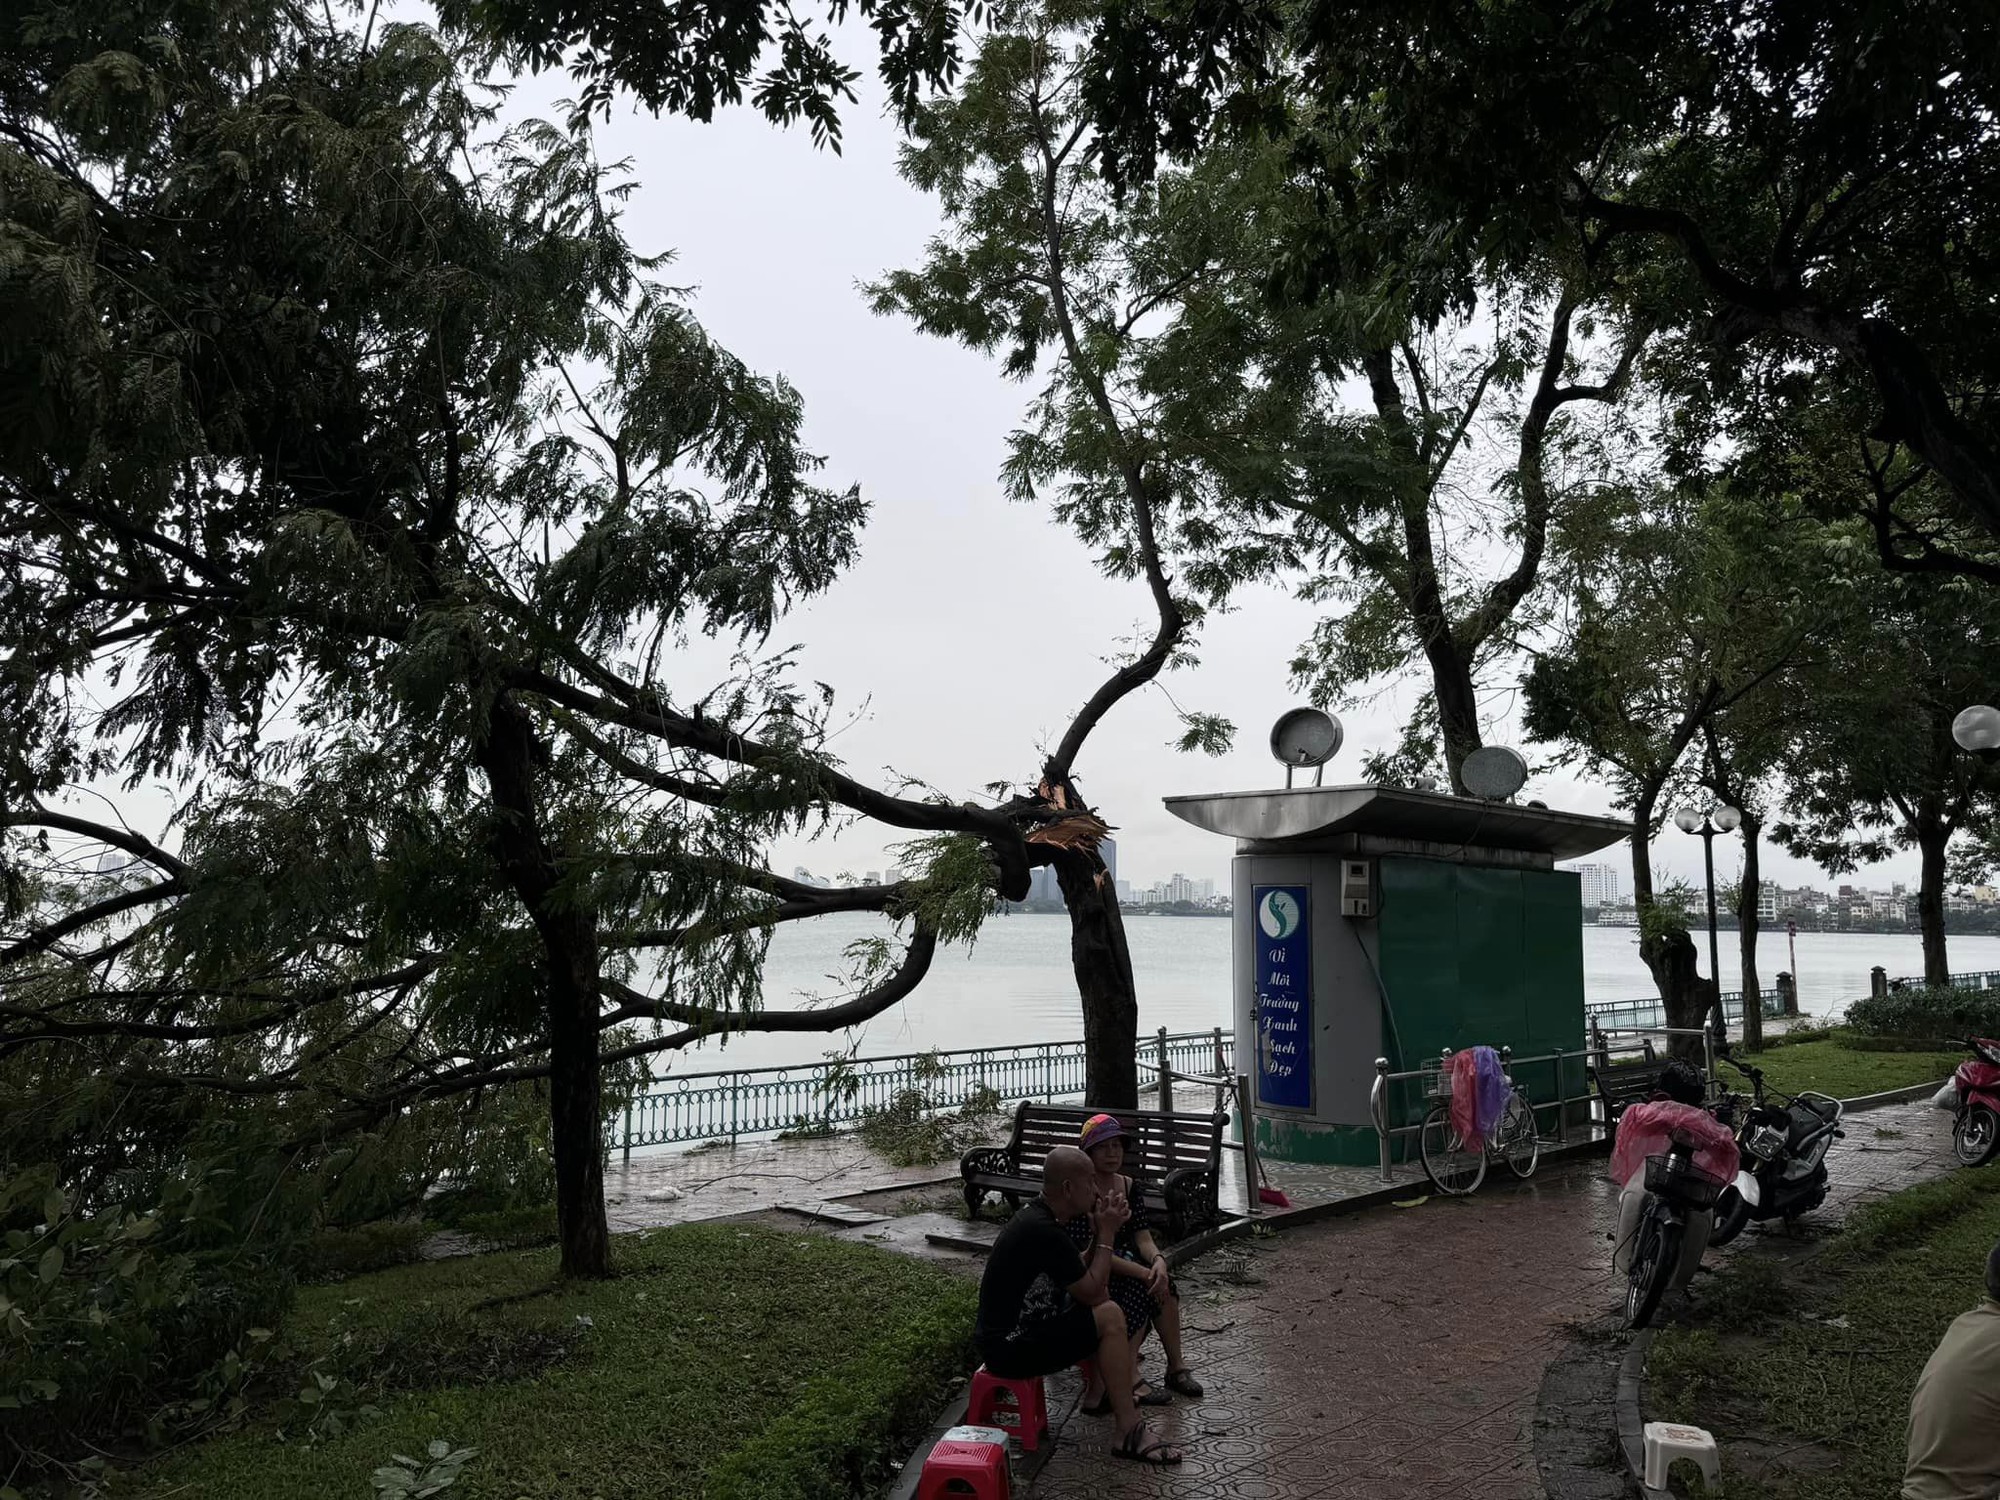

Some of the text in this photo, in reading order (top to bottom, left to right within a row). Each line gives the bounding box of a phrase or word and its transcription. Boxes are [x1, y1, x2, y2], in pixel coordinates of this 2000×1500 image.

[1269, 947, 1287, 963] Vì
[1267, 972, 1290, 986] Môi
[1263, 1016, 1297, 1031] Xanh
